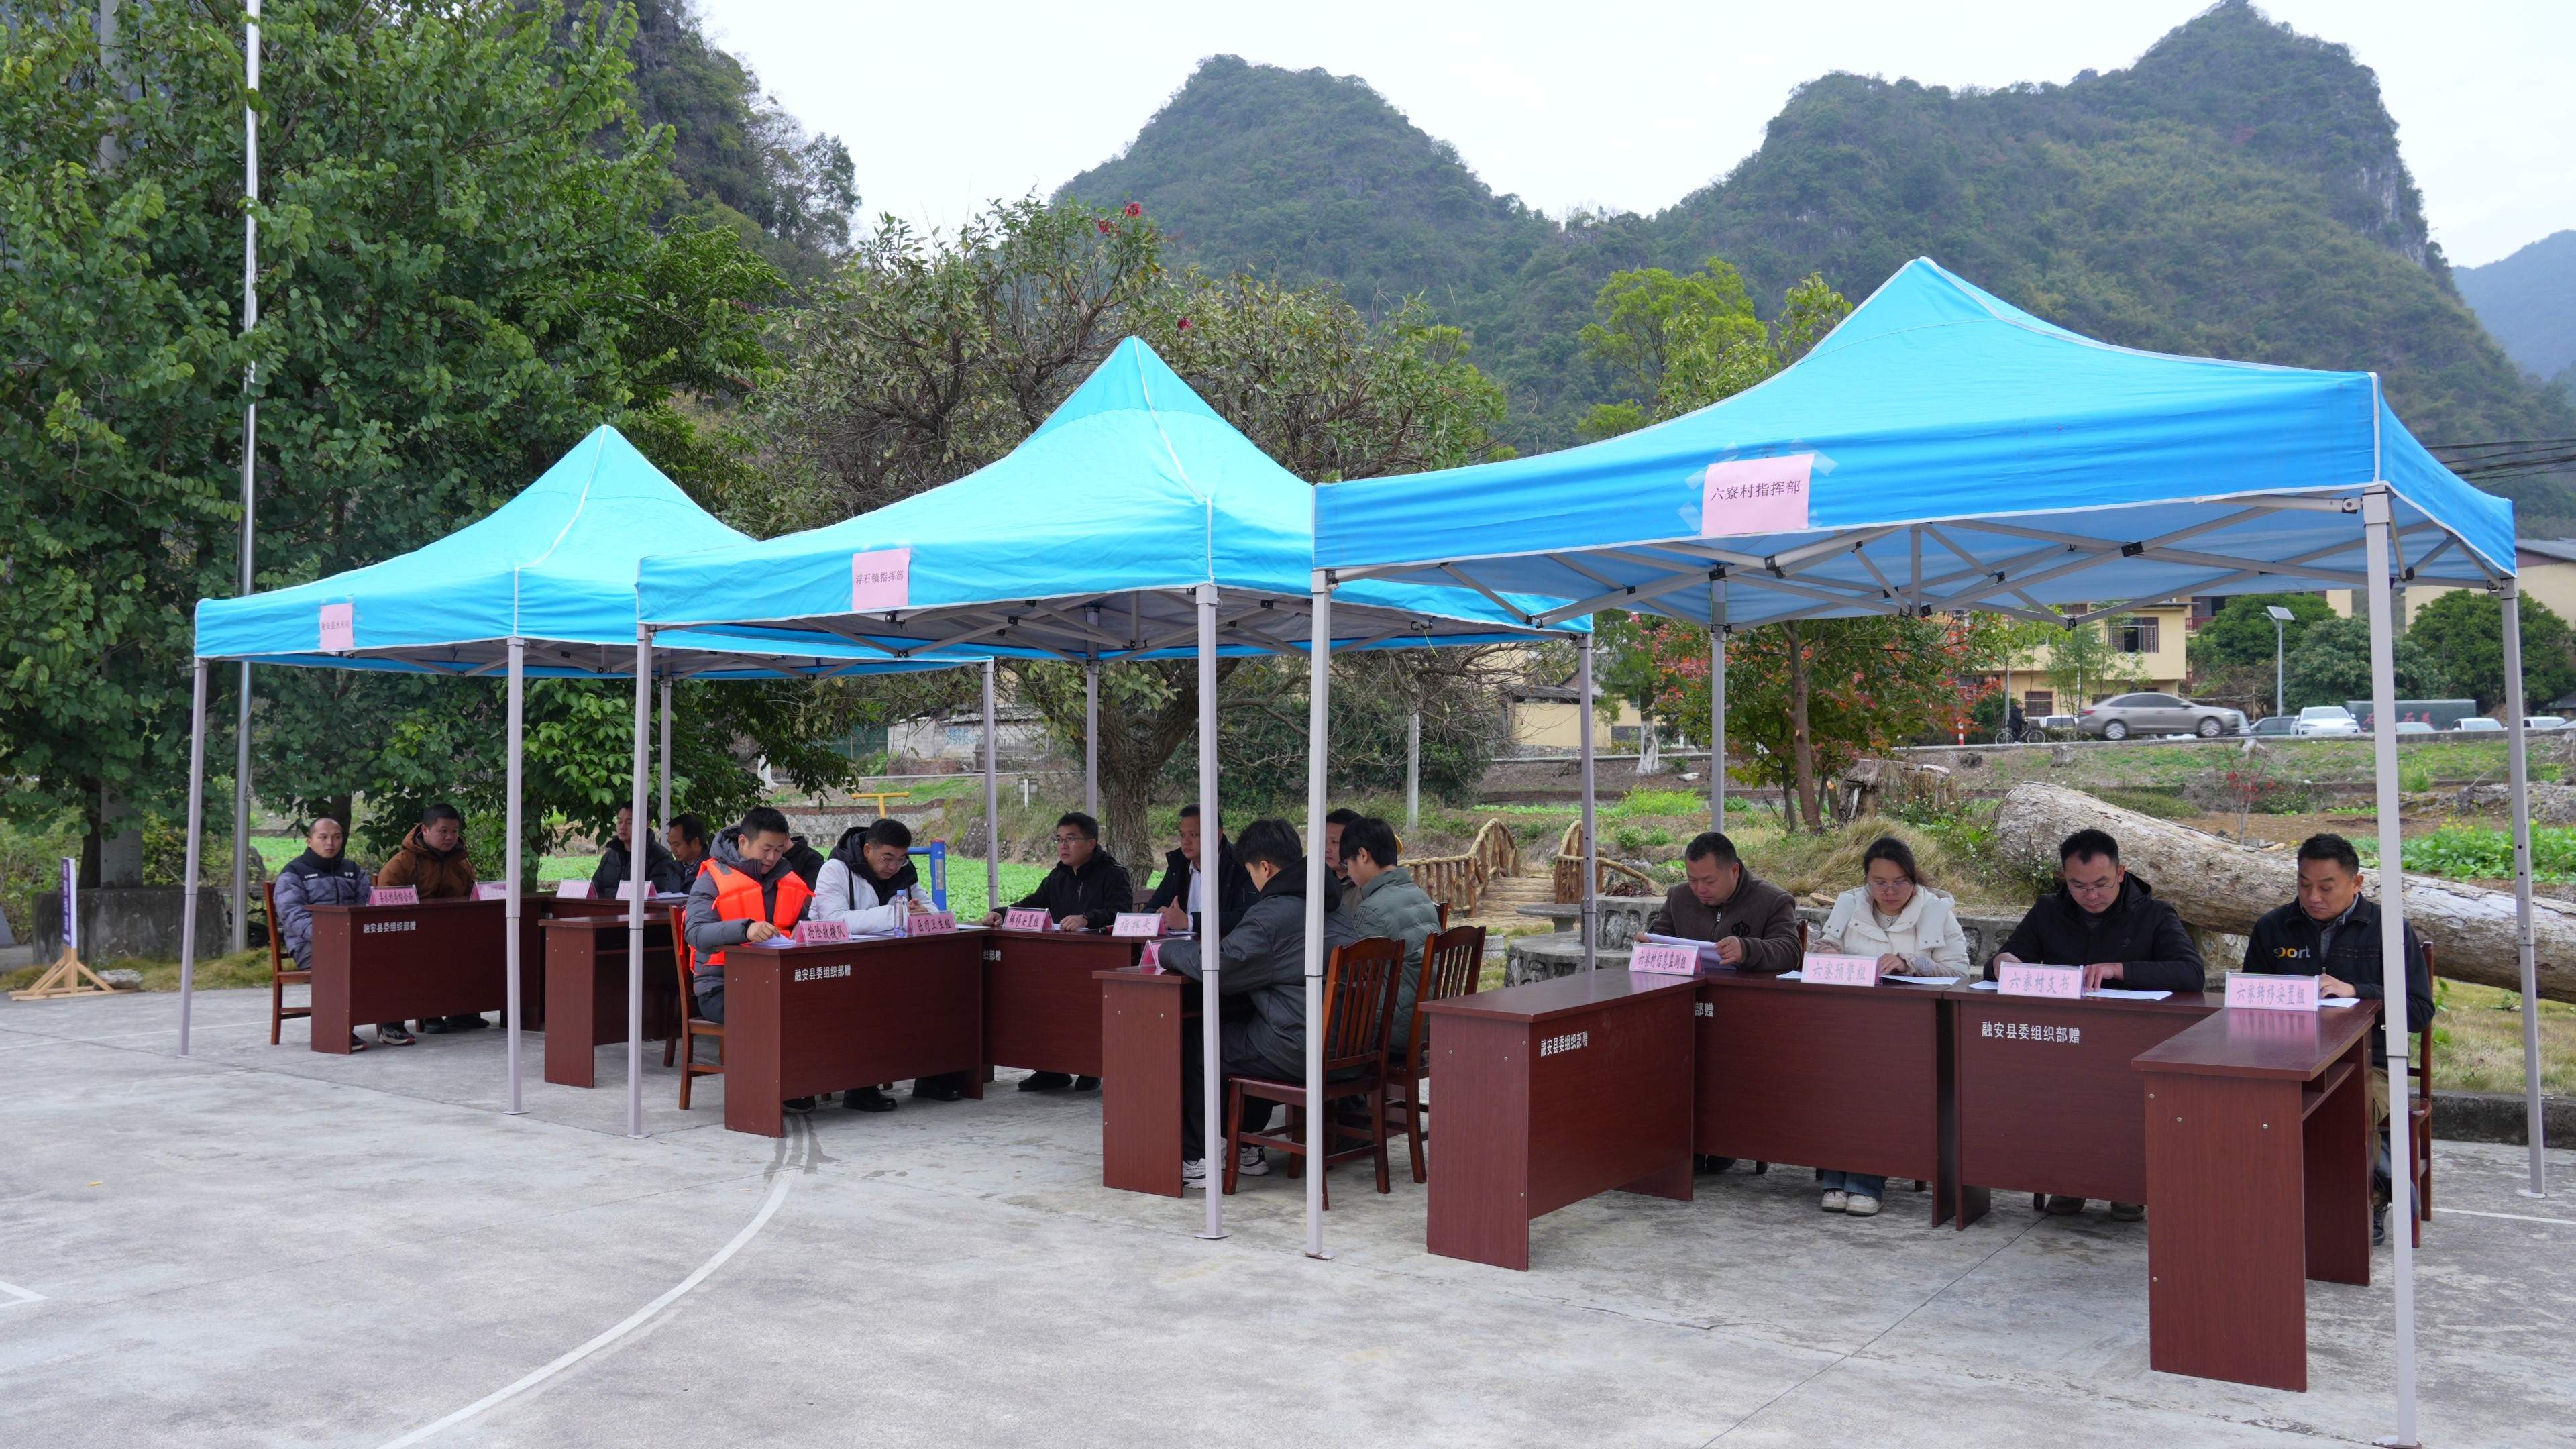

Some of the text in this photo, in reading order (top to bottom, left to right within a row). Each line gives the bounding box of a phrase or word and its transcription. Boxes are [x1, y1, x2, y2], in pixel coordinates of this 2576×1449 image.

[1710, 480, 1801, 502] 六寮村指挥部
[855, 570, 904, 585] 浮石镇指挥部
[363, 920, 416, 934] 融安县委组织部赠
[917, 918, 951, 932] 医疗卫生组
[1009, 912, 1040, 928] 转移安置组
[1120, 918, 1152, 934] 指挥长
[807, 923, 845, 940] 抢险救援队
[794, 963, 851, 982] 融安县委组织部赠
[1695, 1002, 1714, 1018] 部赠
[1982, 1021, 2080, 1044] 融安县委组织部赠
[1540, 1030, 1588, 1057] 融安县委组织部赠
